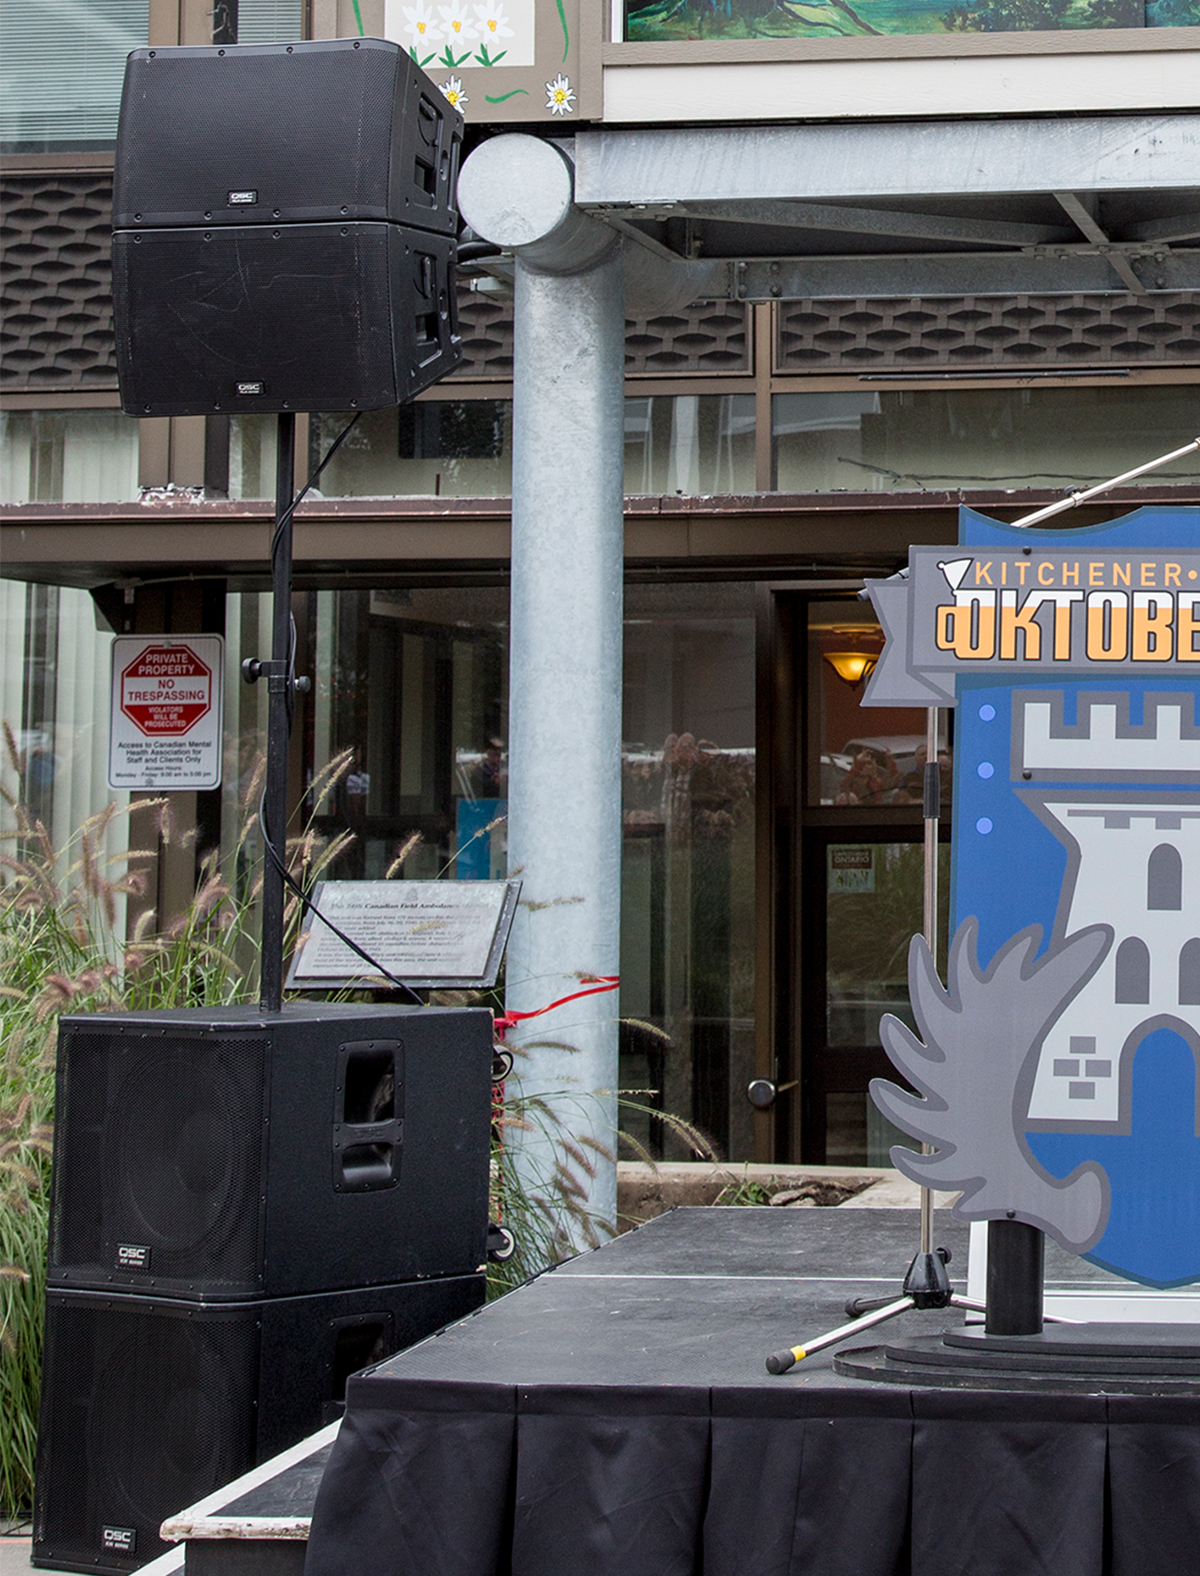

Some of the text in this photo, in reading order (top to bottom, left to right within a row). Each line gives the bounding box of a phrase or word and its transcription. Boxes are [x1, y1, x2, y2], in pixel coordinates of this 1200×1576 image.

[146, 653, 188, 664] PRIVATE
[138, 665, 195, 675] PROPERTY
[158, 679, 174, 689] NO
[127, 690, 205, 702] TRESPASSING
[148, 706, 184, 714] VIOLATORS
[144, 720, 186, 728] PROSECUTED
[117, 741, 144, 749] Access
[153, 741, 186, 749] Canadian
[126, 756, 143, 764] Staff
[144, 756, 157, 764] and
[185, 756, 201, 764] Only
[119, 1246, 145, 1259] QSC
[104, 1529, 131, 1542] QSC
